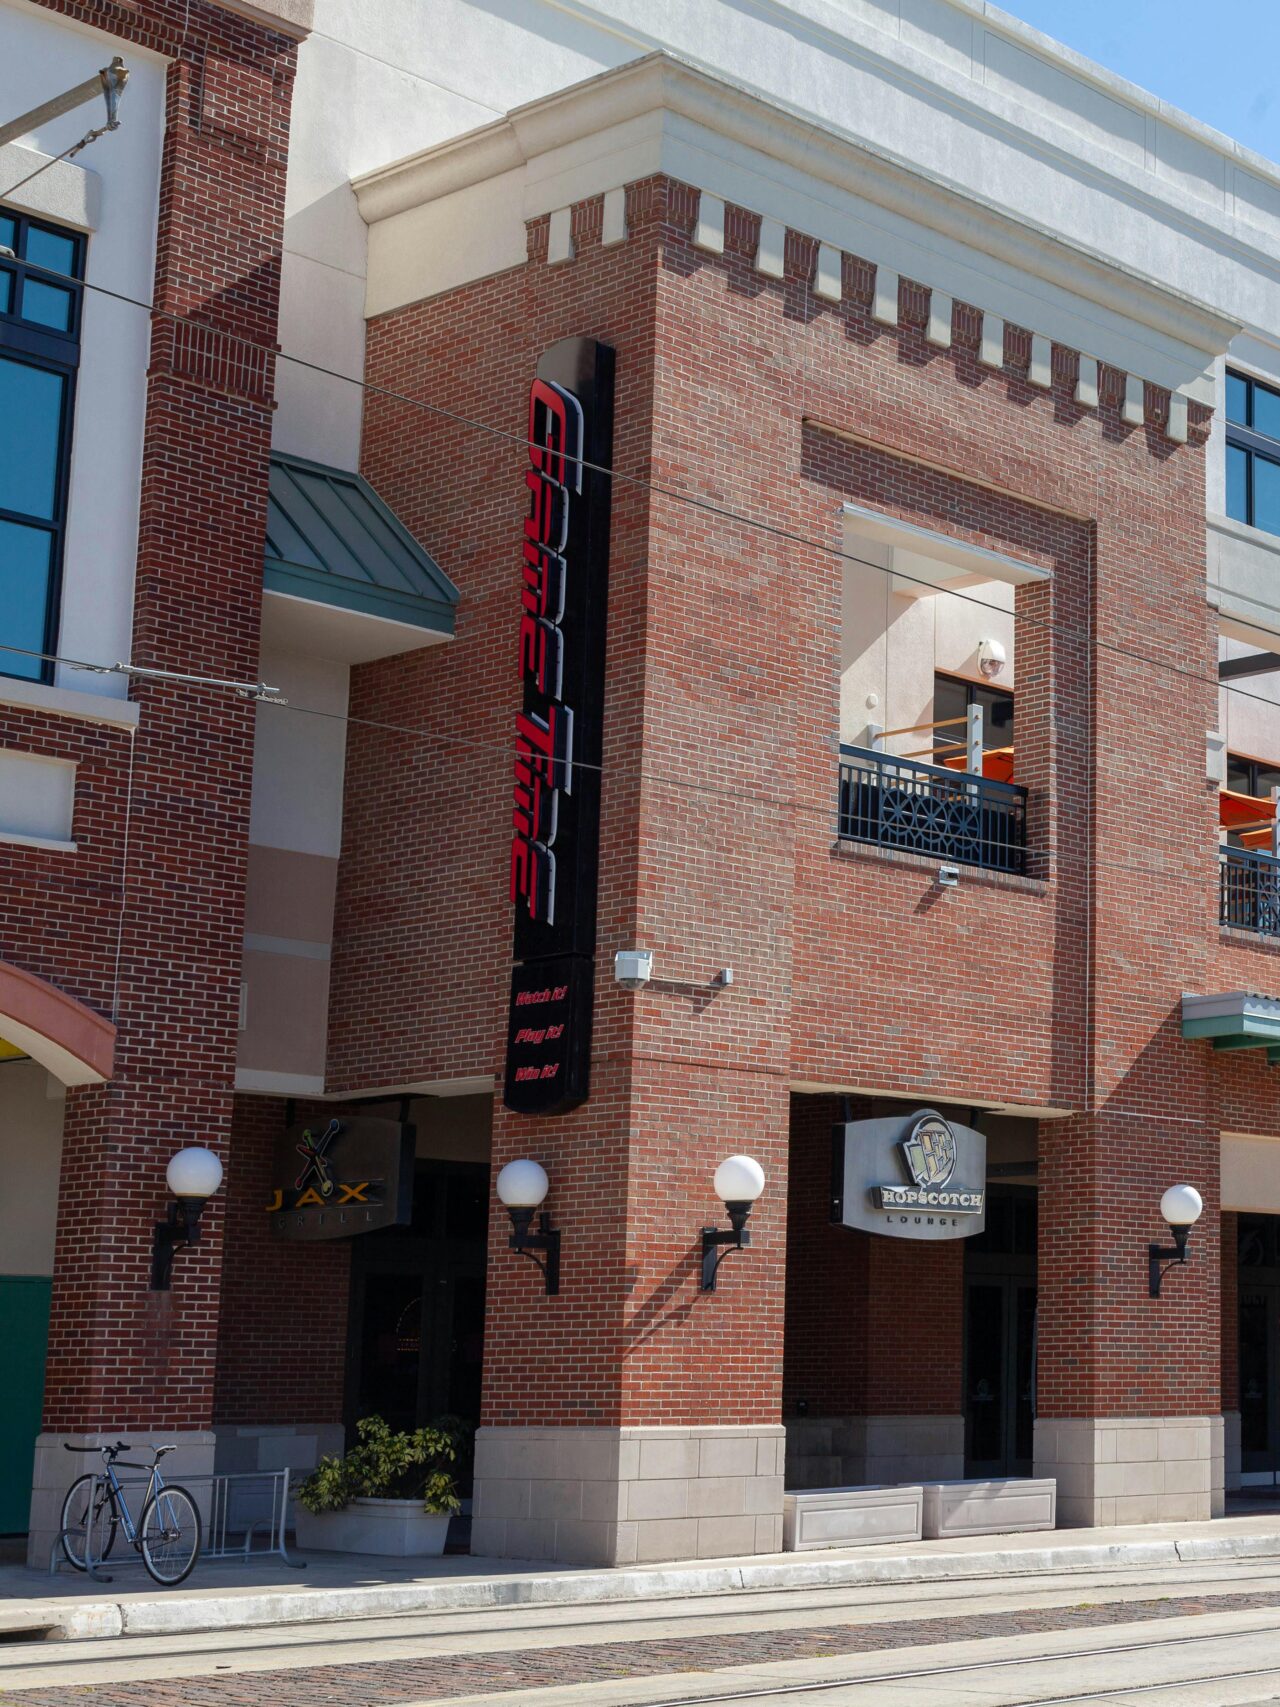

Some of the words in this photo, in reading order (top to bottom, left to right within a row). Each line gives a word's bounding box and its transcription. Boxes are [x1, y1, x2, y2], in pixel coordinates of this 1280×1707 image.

[515, 989, 551, 1005] Watch
[552, 987, 568, 1001] it!
[514, 1029, 546, 1044] Play
[546, 1024, 565, 1040] it!
[514, 1067, 541, 1081] Win
[541, 1063, 559, 1078] it!
[265, 1182, 369, 1211] JAX
[883, 1191, 981, 1206] HOPSCOTCH
[278, 1211, 373, 1229] GRILL
[887, 1216, 958, 1227] LOUNGE
